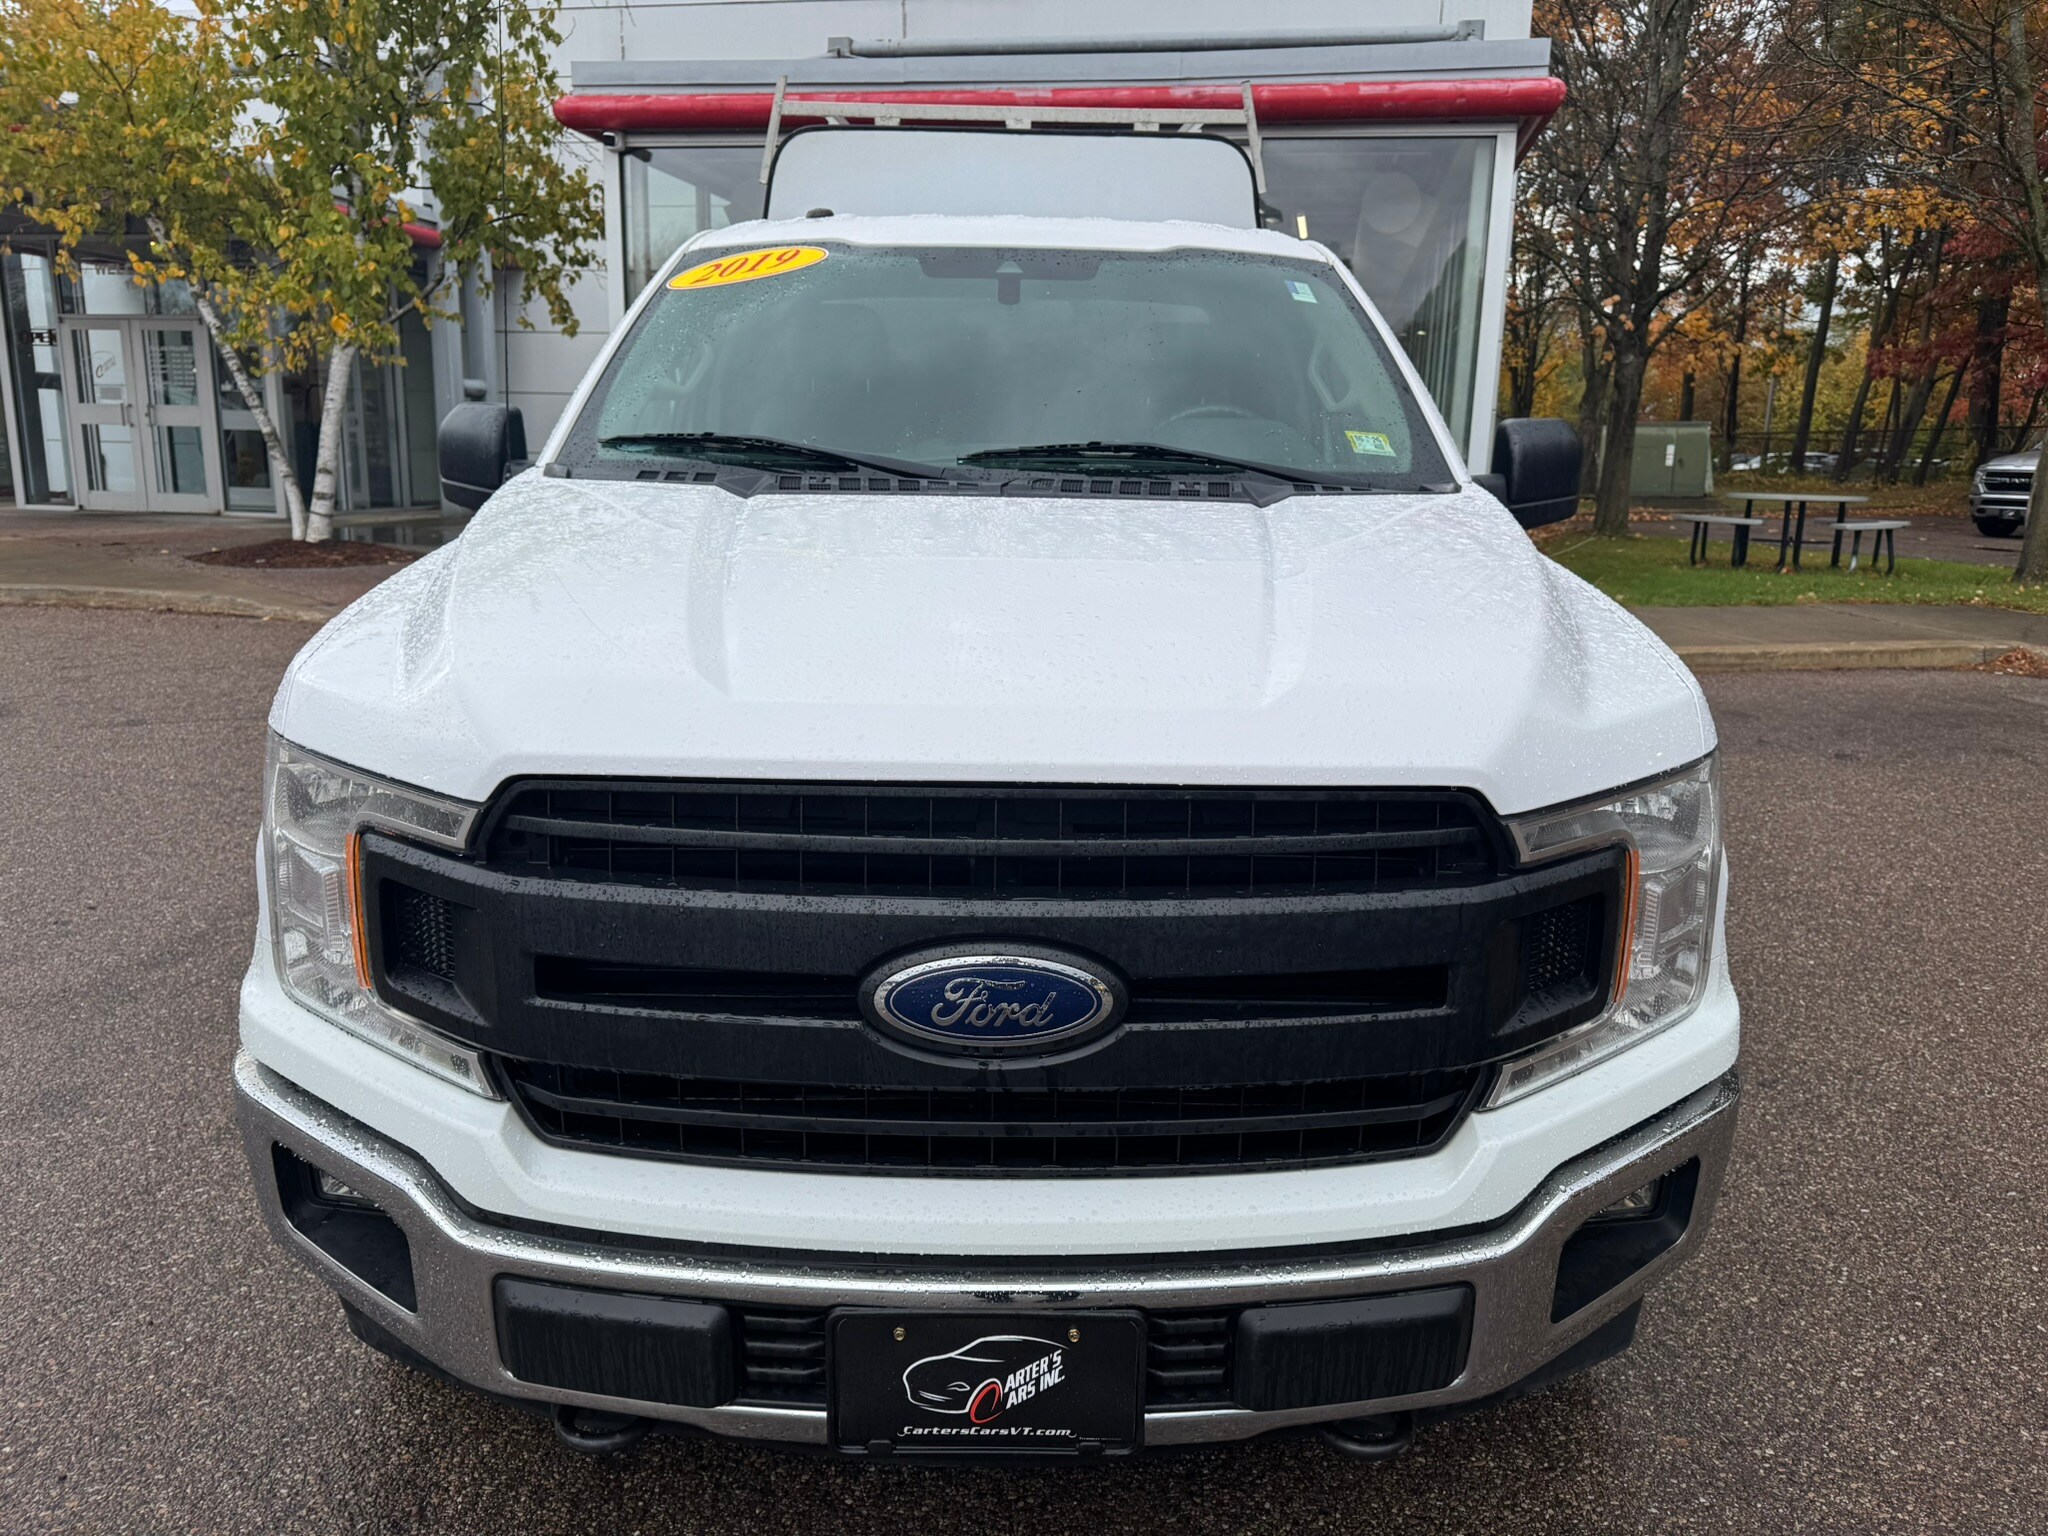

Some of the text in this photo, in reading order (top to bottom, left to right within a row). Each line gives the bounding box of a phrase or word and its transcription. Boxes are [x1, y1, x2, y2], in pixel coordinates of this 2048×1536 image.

[689, 249, 801, 285] 2019
[931, 976, 1056, 1027] Ford
[1039, 1365, 1066, 1392] INC.
[898, 1426, 1076, 1438] CartersCarsVT.com
